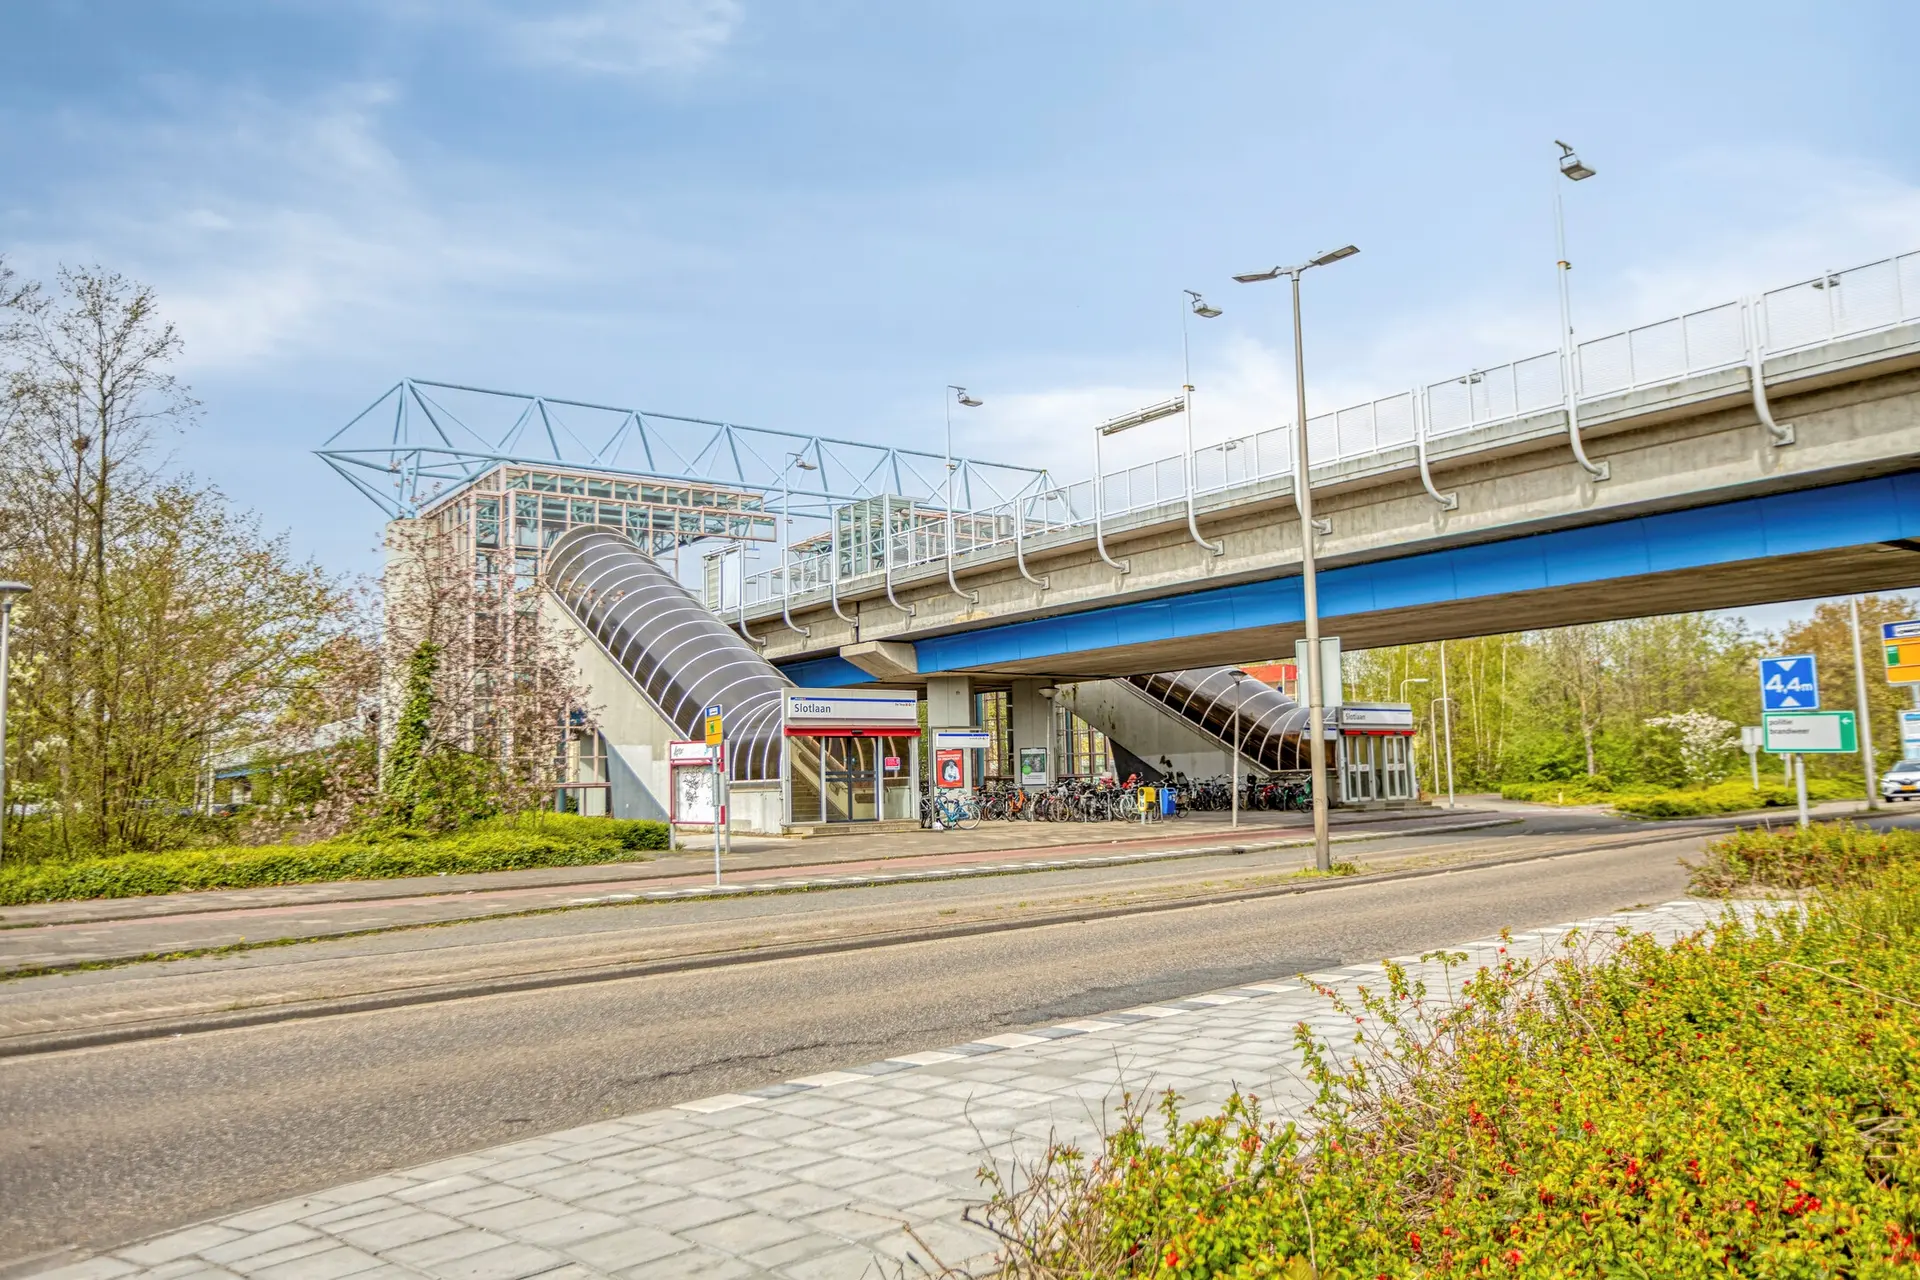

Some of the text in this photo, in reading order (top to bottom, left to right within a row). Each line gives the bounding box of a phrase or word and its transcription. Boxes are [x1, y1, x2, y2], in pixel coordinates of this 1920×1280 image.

[1765, 674, 1813, 694] 4,4m
[794, 703, 831, 713] Slotlaan
[1345, 712, 1366, 720] Slotlaan
